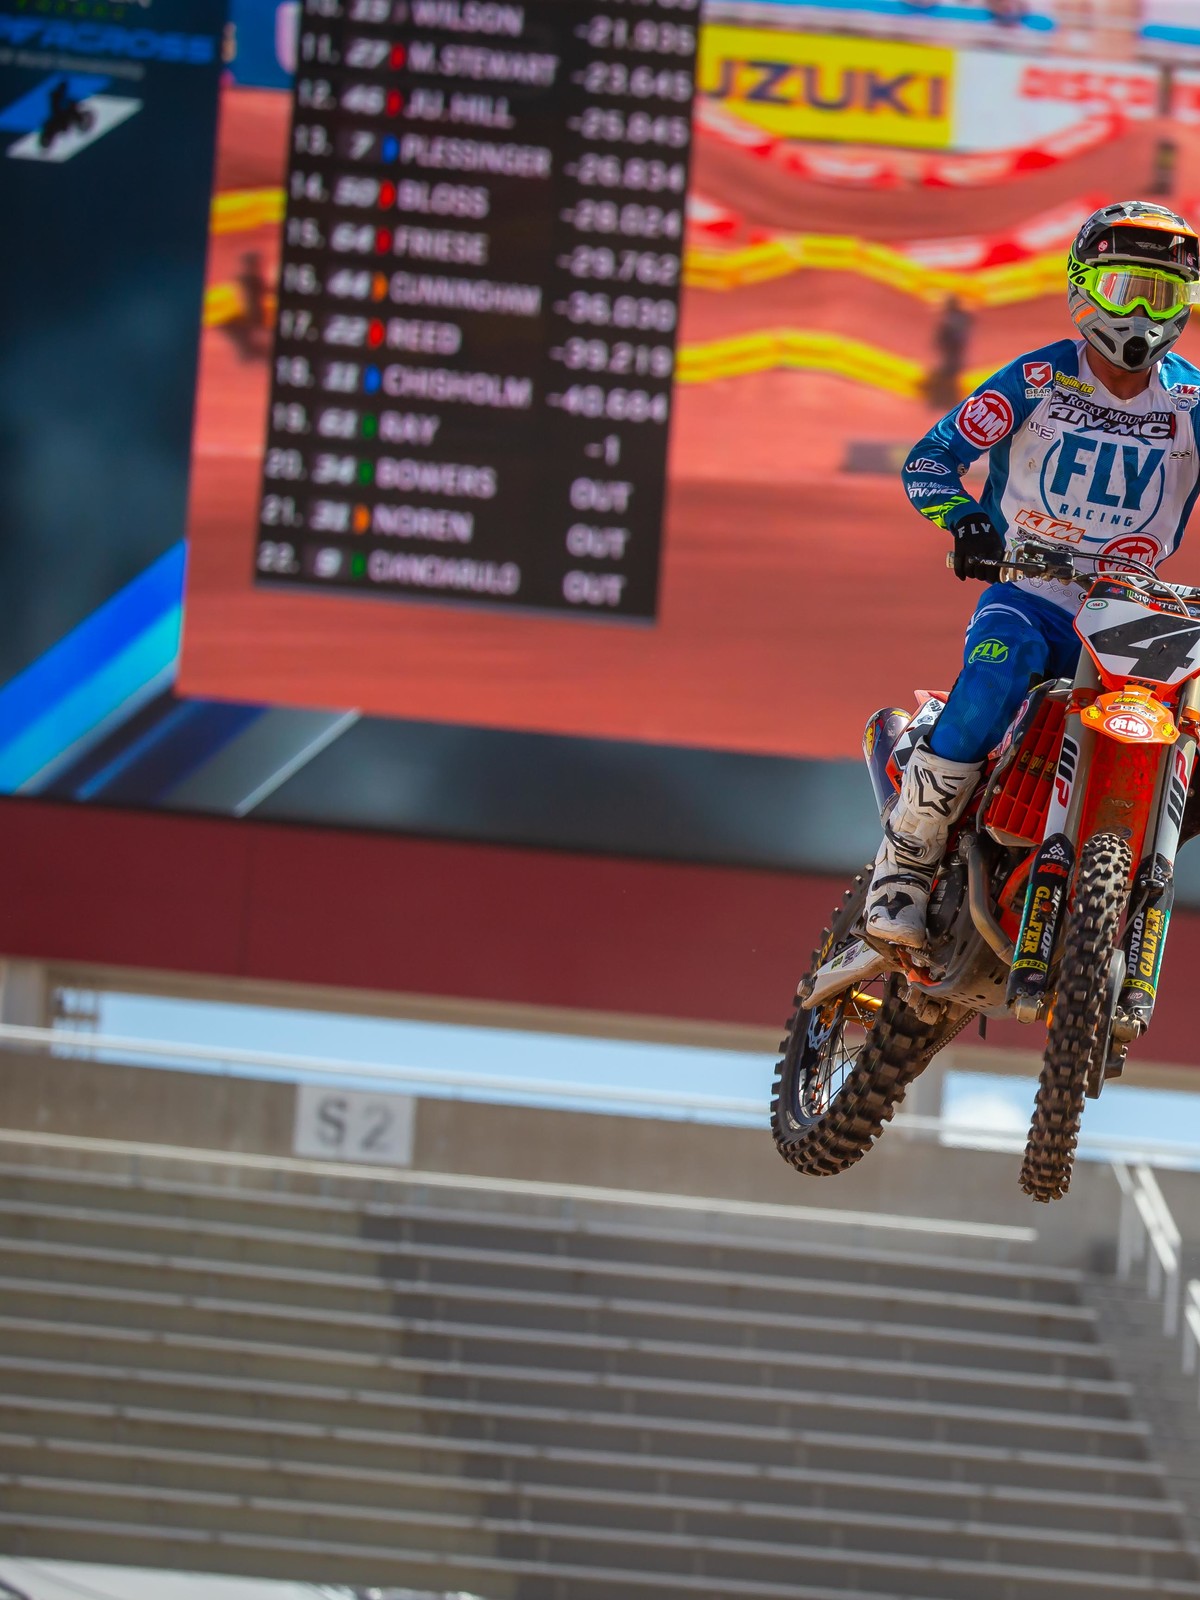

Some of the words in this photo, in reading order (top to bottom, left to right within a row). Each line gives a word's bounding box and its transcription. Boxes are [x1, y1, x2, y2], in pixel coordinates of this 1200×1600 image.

[411, 0, 524, 37] WILSON
[401, 133, 551, 178] PLESSINGER
[398, 179, 490, 219] BLOSS
[393, 224, 490, 266] FRIESE
[386, 317, 462, 355] REED
[382, 363, 533, 409] CHISHOLM
[378, 410, 440, 446] RAY
[1067, 395, 1104, 417] ROCKY
[1105, 409, 1170, 425] MOUNTAIN
[375, 456, 497, 498] BOWERS
[570, 477, 634, 514] OUT
[1051, 432, 1165, 511] FLY
[372, 503, 474, 543] NOREN
[566, 523, 631, 560] OUT
[957, 522, 991, 538] FLY
[1015, 509, 1086, 544] KTM
[1059, 503, 1133, 527] RACING
[563, 570, 628, 606] OUT
[974, 643, 1009, 659] FLY
[1037, 863, 1068, 878] KTM
[1139, 906, 1161, 977] GALFER
